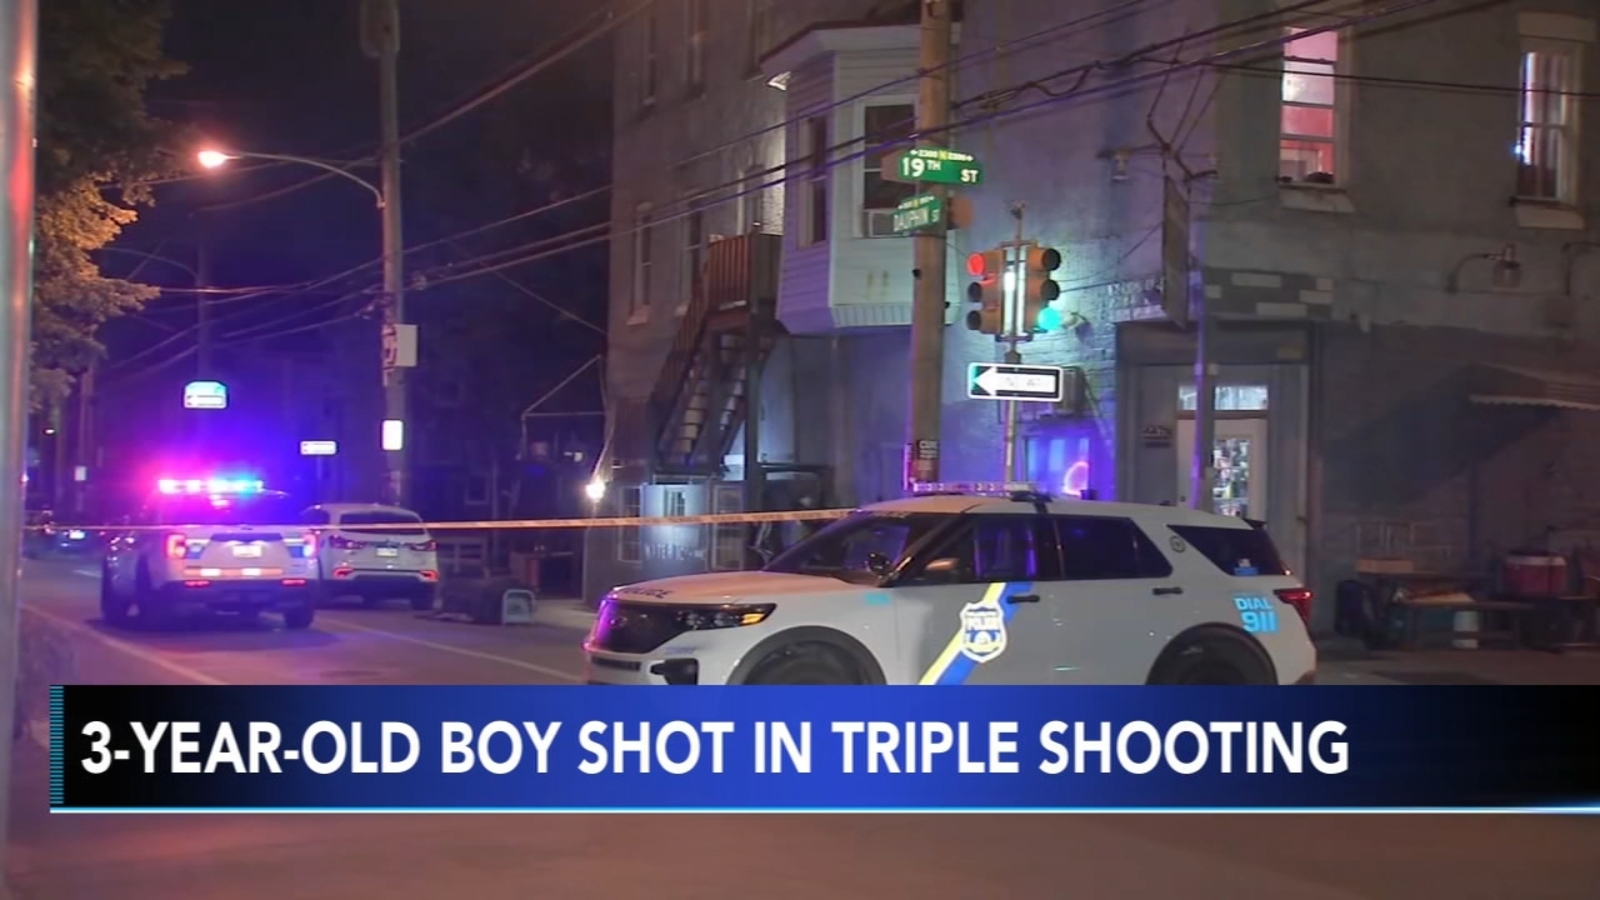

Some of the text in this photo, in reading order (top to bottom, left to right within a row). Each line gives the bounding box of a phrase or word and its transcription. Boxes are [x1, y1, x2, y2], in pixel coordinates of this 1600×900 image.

[903, 157, 979, 183] 19TH ST
[1234, 597, 1274, 610] DIAL
[1240, 610, 1277, 632] 911
